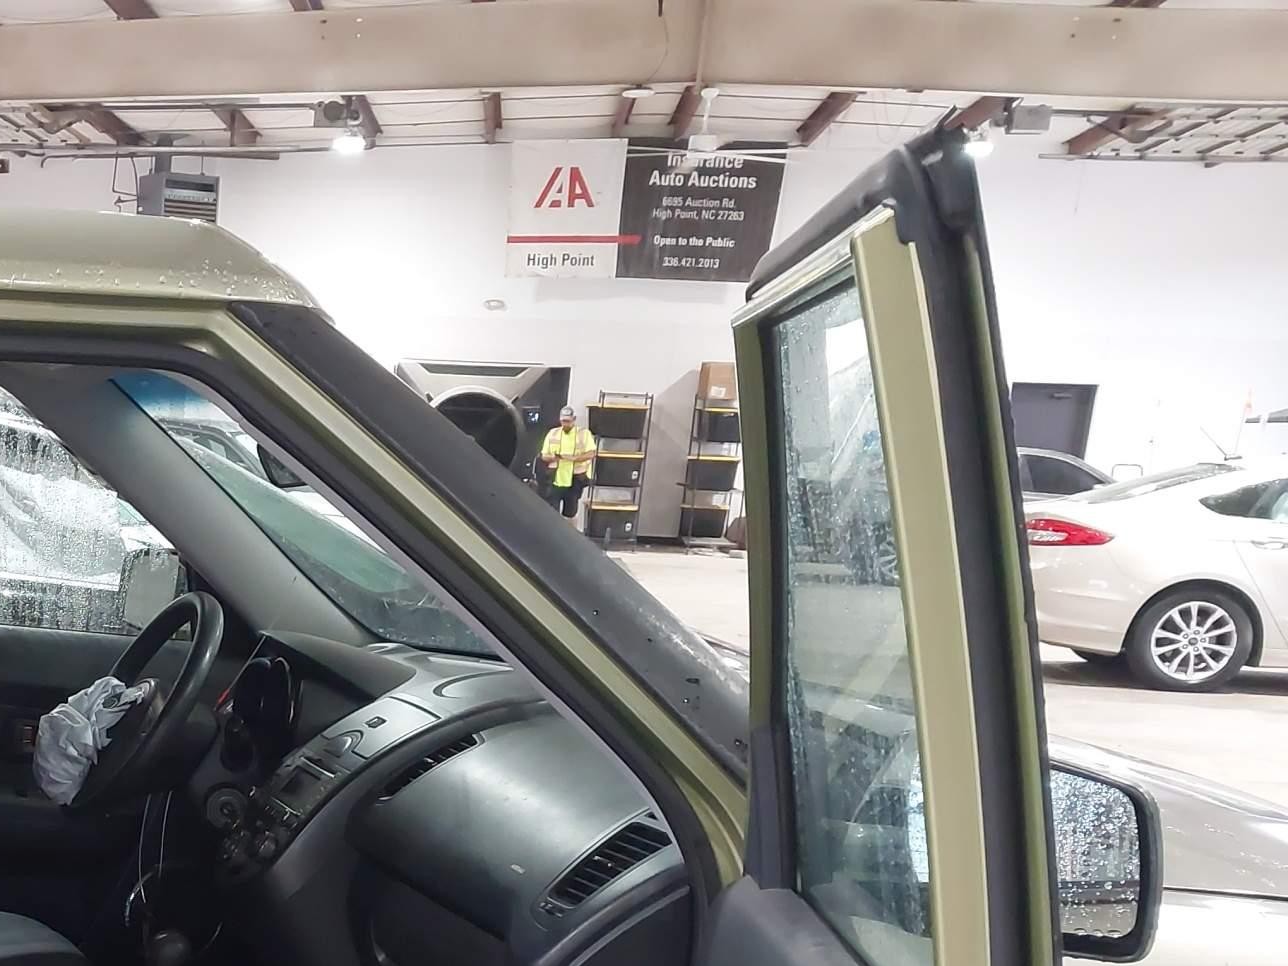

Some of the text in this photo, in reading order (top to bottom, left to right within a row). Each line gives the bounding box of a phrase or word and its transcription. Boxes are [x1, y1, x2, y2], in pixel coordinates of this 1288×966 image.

[667, 152, 744, 168] Inrance
[648, 170, 758, 189] Auto Auctions
[685, 197, 720, 207] Auction
[721, 198, 736, 208] Rd.
[652, 208, 672, 220] High
[701, 210, 716, 220] NC
[653, 235, 735, 247] Open to the Public
[527, 253, 595, 269] High Point
